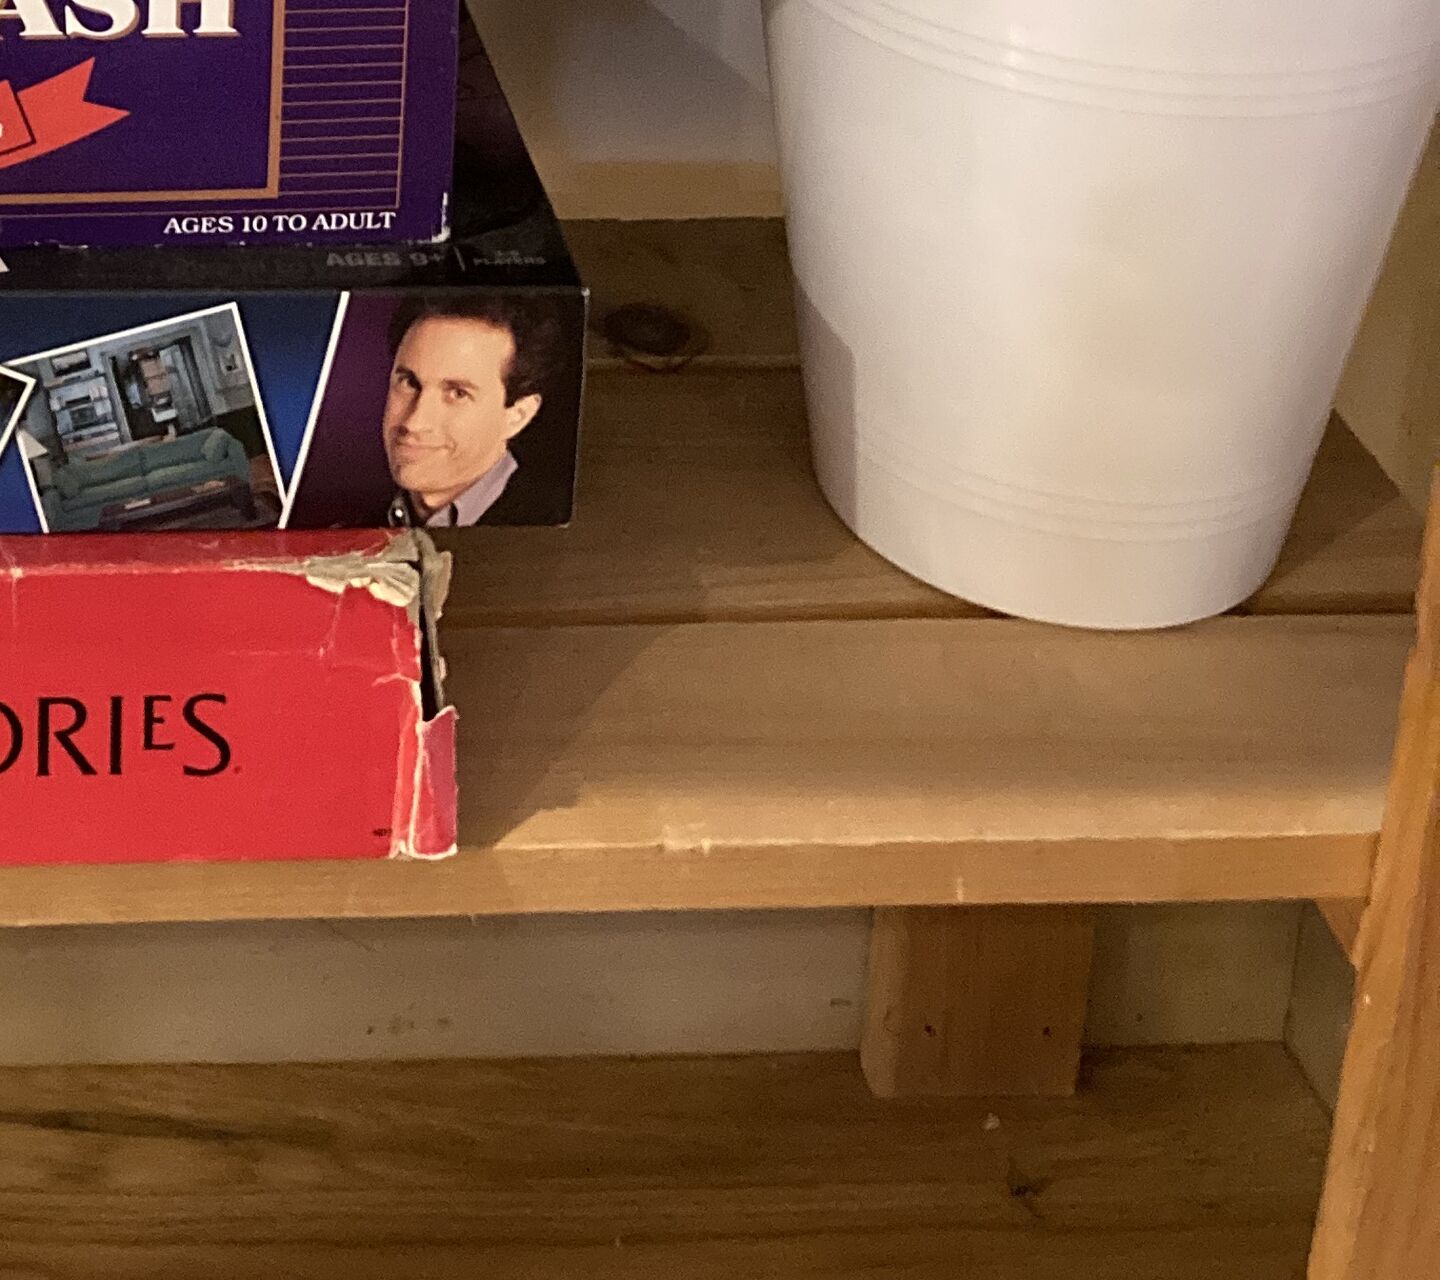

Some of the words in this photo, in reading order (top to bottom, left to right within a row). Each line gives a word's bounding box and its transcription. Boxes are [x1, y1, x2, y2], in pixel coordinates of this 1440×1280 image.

[164, 216, 234, 235] AGES
[242, 215, 267, 232] 10
[272, 214, 307, 232] TO
[313, 211, 396, 232] ADULT
